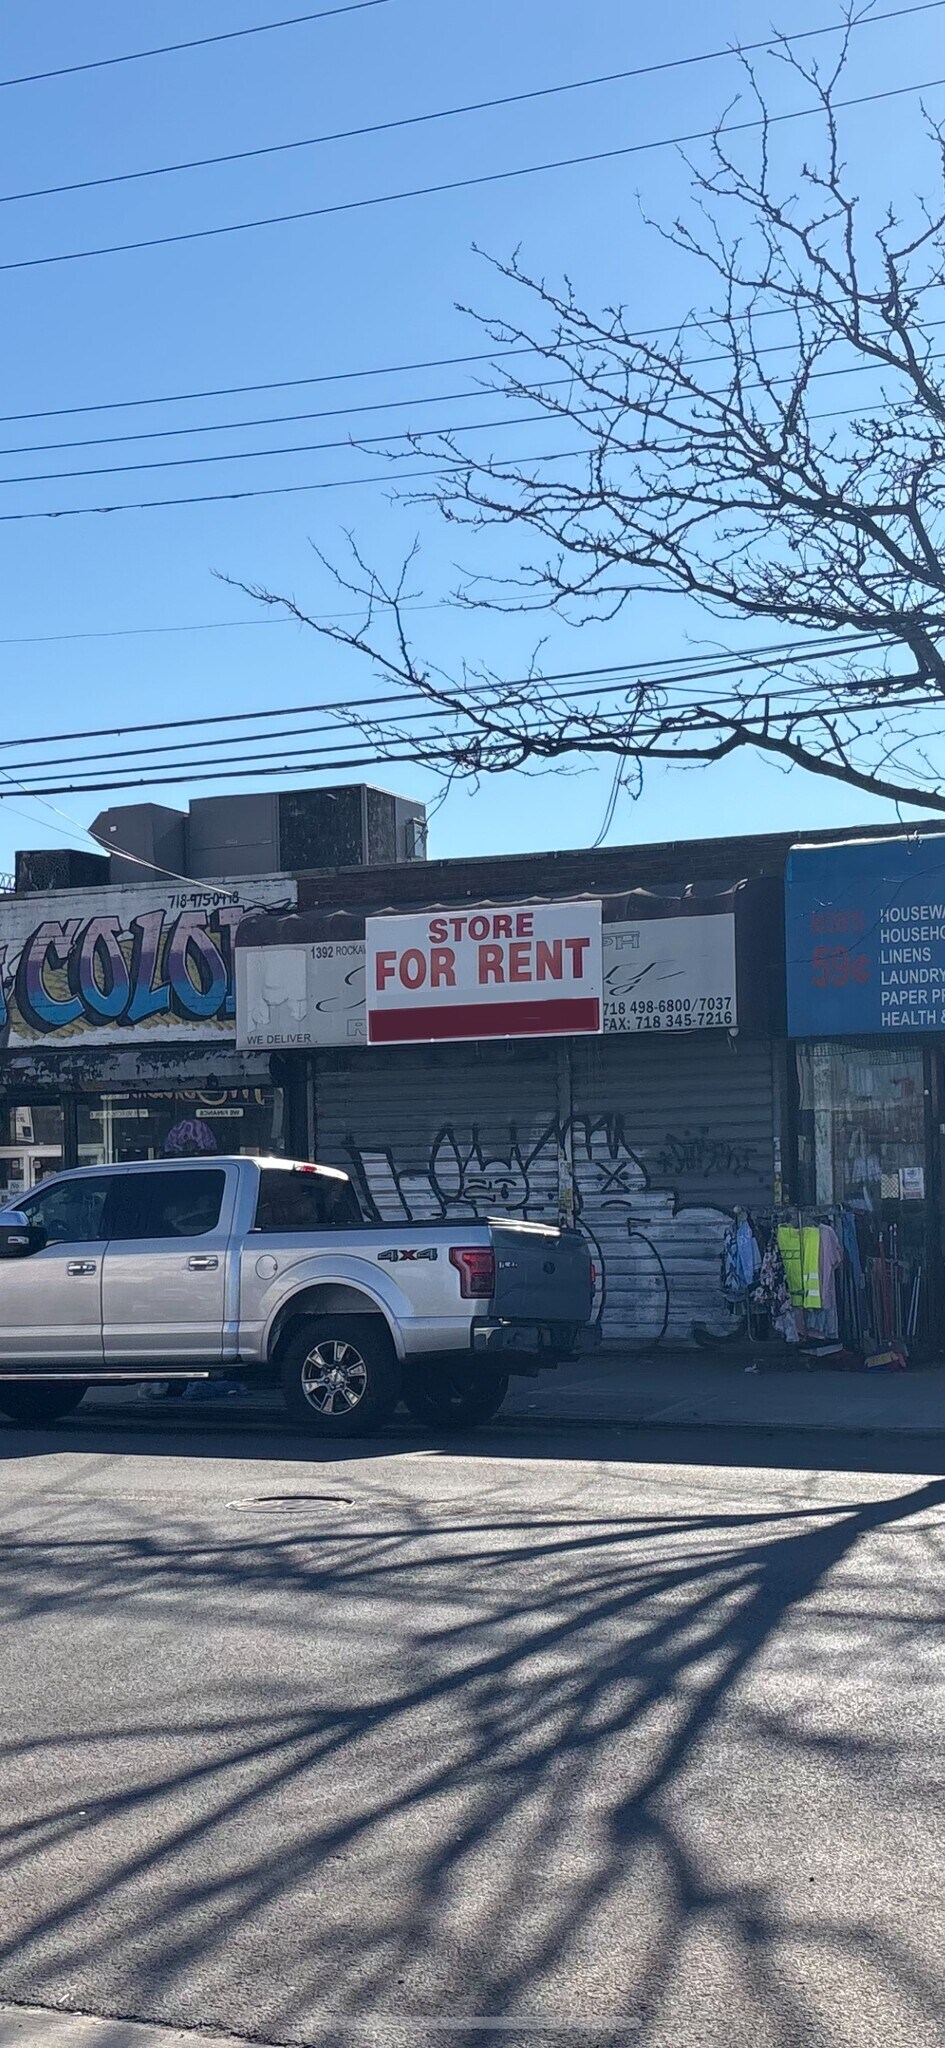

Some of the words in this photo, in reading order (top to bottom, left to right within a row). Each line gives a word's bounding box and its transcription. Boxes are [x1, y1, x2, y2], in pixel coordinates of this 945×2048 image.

[880, 904, 945, 924] HOUSEW
[428, 912, 534, 944] STORE
[311, 946, 334, 960] 1392
[880, 946, 932, 965] LINENS
[375, 947, 457, 991] FOR
[478, 937, 591, 985] RENT
[603, 1001, 626, 1016] 718
[629, 996, 732, 1015] 498-6800/7037
[881, 988, 928, 1006] PAPER
[603, 1017, 631, 1031] FAX:
[635, 1015, 661, 1029] 718
[665, 1011, 733, 1028] 345-7216
[881, 1009, 937, 1027] HEALTH
[247, 1035, 263, 1045] WE
[266, 1033, 312, 1045] DELIVER
